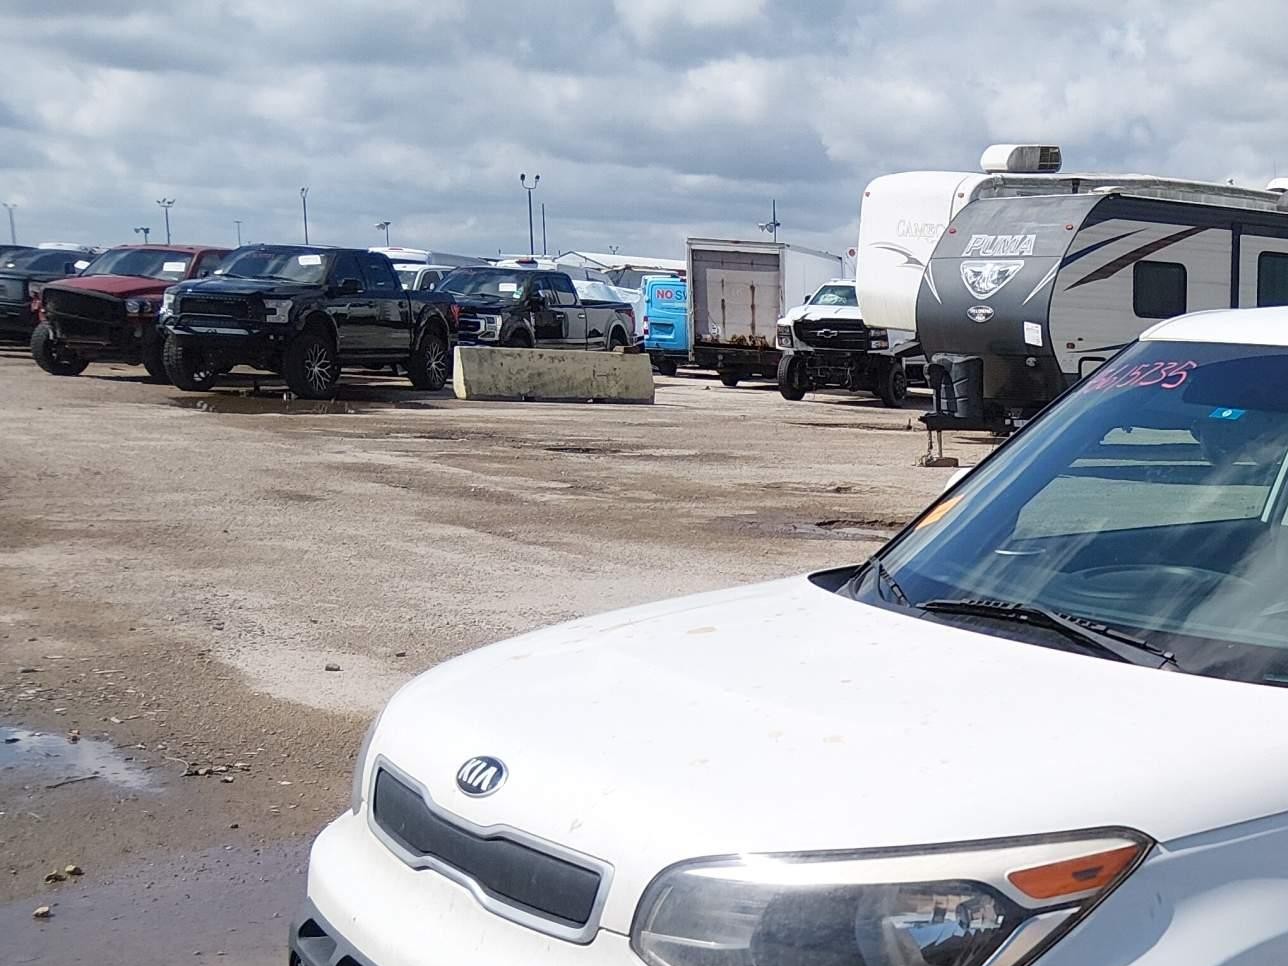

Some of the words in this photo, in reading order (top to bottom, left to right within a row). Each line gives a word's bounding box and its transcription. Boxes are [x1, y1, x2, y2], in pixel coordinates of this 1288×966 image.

[961, 234, 1037, 257] PUMA
[656, 289, 673, 299] NO
[457, 757, 498, 792] KIA
